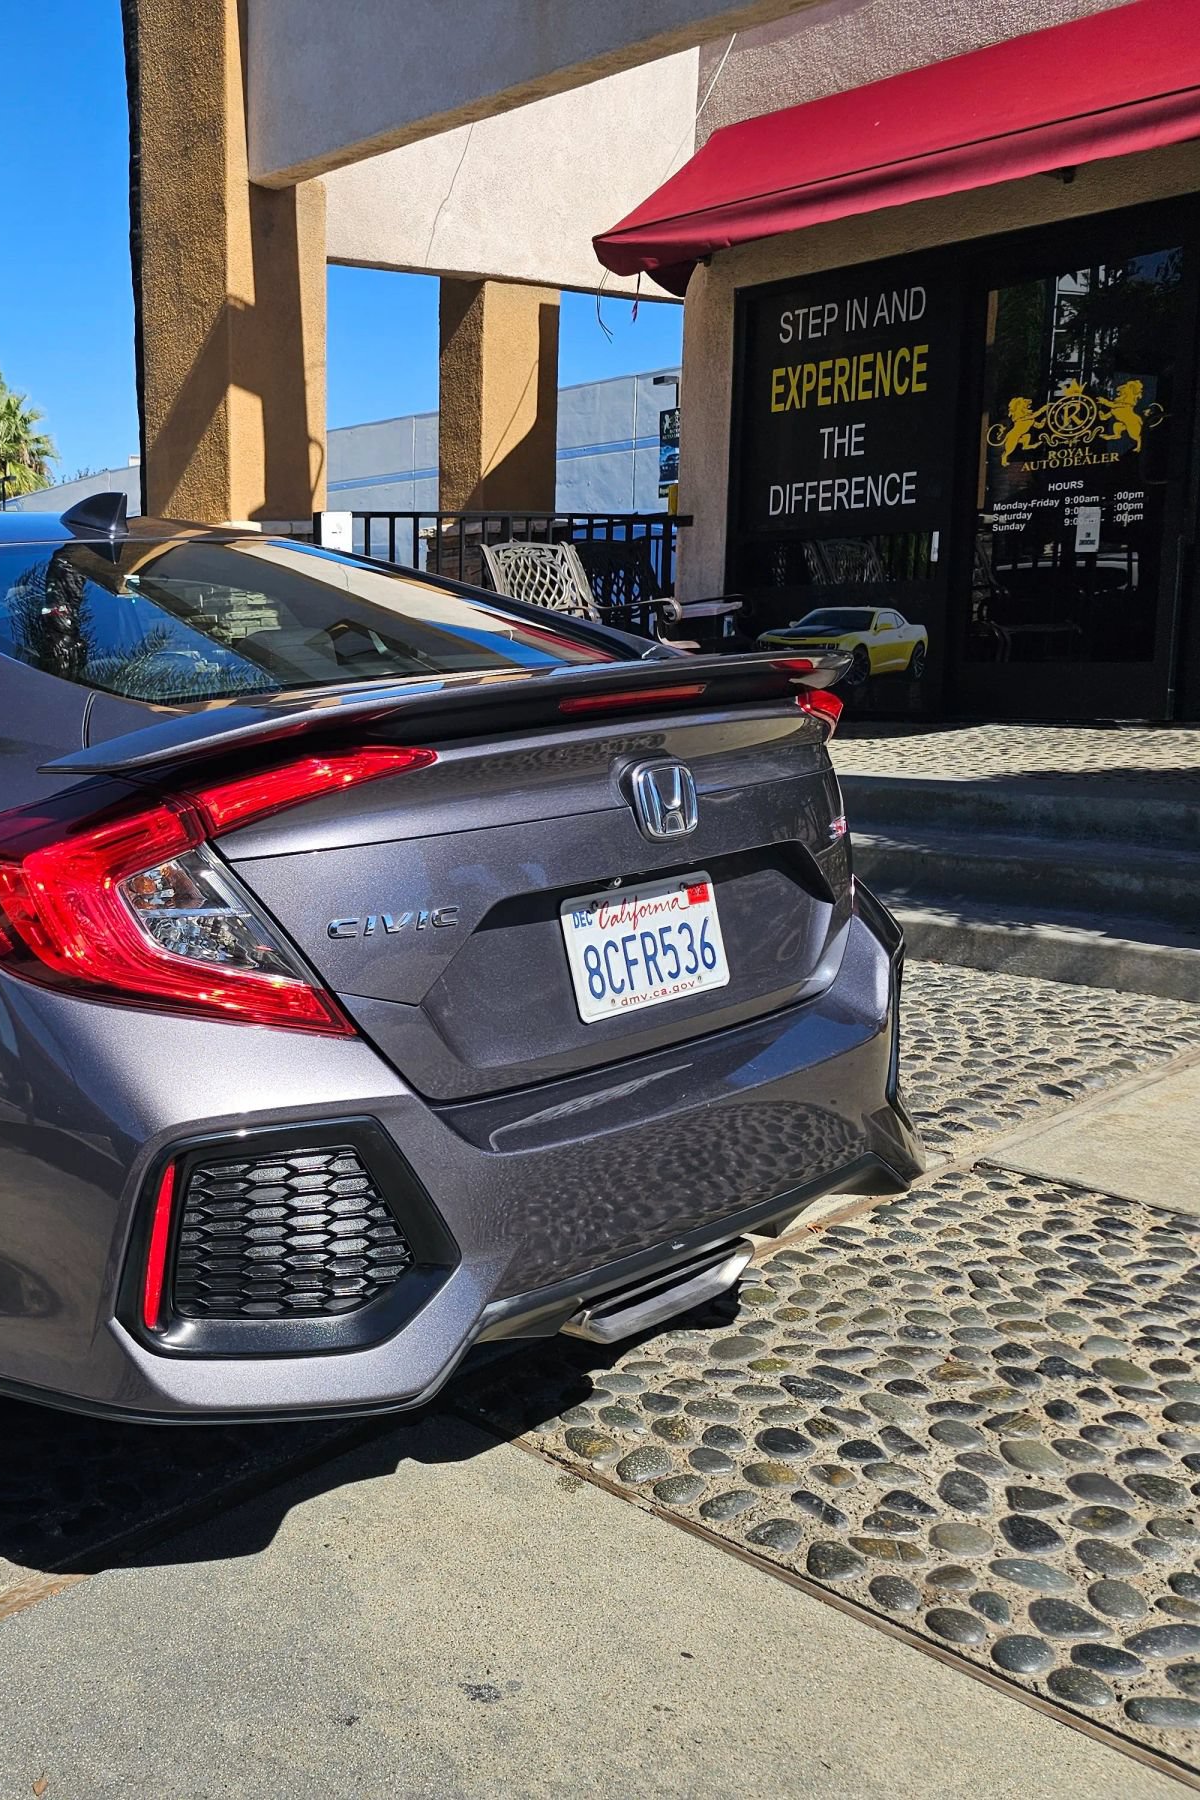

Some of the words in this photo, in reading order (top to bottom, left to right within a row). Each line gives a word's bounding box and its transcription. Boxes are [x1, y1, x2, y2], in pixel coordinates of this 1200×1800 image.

[779, 303, 839, 343] STEP
[845, 296, 868, 332] IN
[873, 286, 927, 327] AND
[771, 344, 929, 413] EXPERIENCE
[819, 423, 866, 459] THE
[1048, 446, 1093, 460] ROYAL
[1020, 457, 1060, 472] AUTO
[1063, 452, 1120, 467] DEALER
[769, 471, 918, 516] DIFFERENCE
[1048, 480, 1084, 492] HOURS
[992, 511, 1033, 522] Saturday
[993, 498, 1060, 511] Monday-Friday
[1064, 495, 1100, 505] 9:00am
[992, 522, 1026, 532] Sunday
[327, 905, 460, 940] CIVIC
[572, 909, 593, 929] DEC
[598, 894, 690, 930] California
[583, 916, 717, 1000] 8CFR536
[621, 979, 695, 1007] dmv.ca.gov
